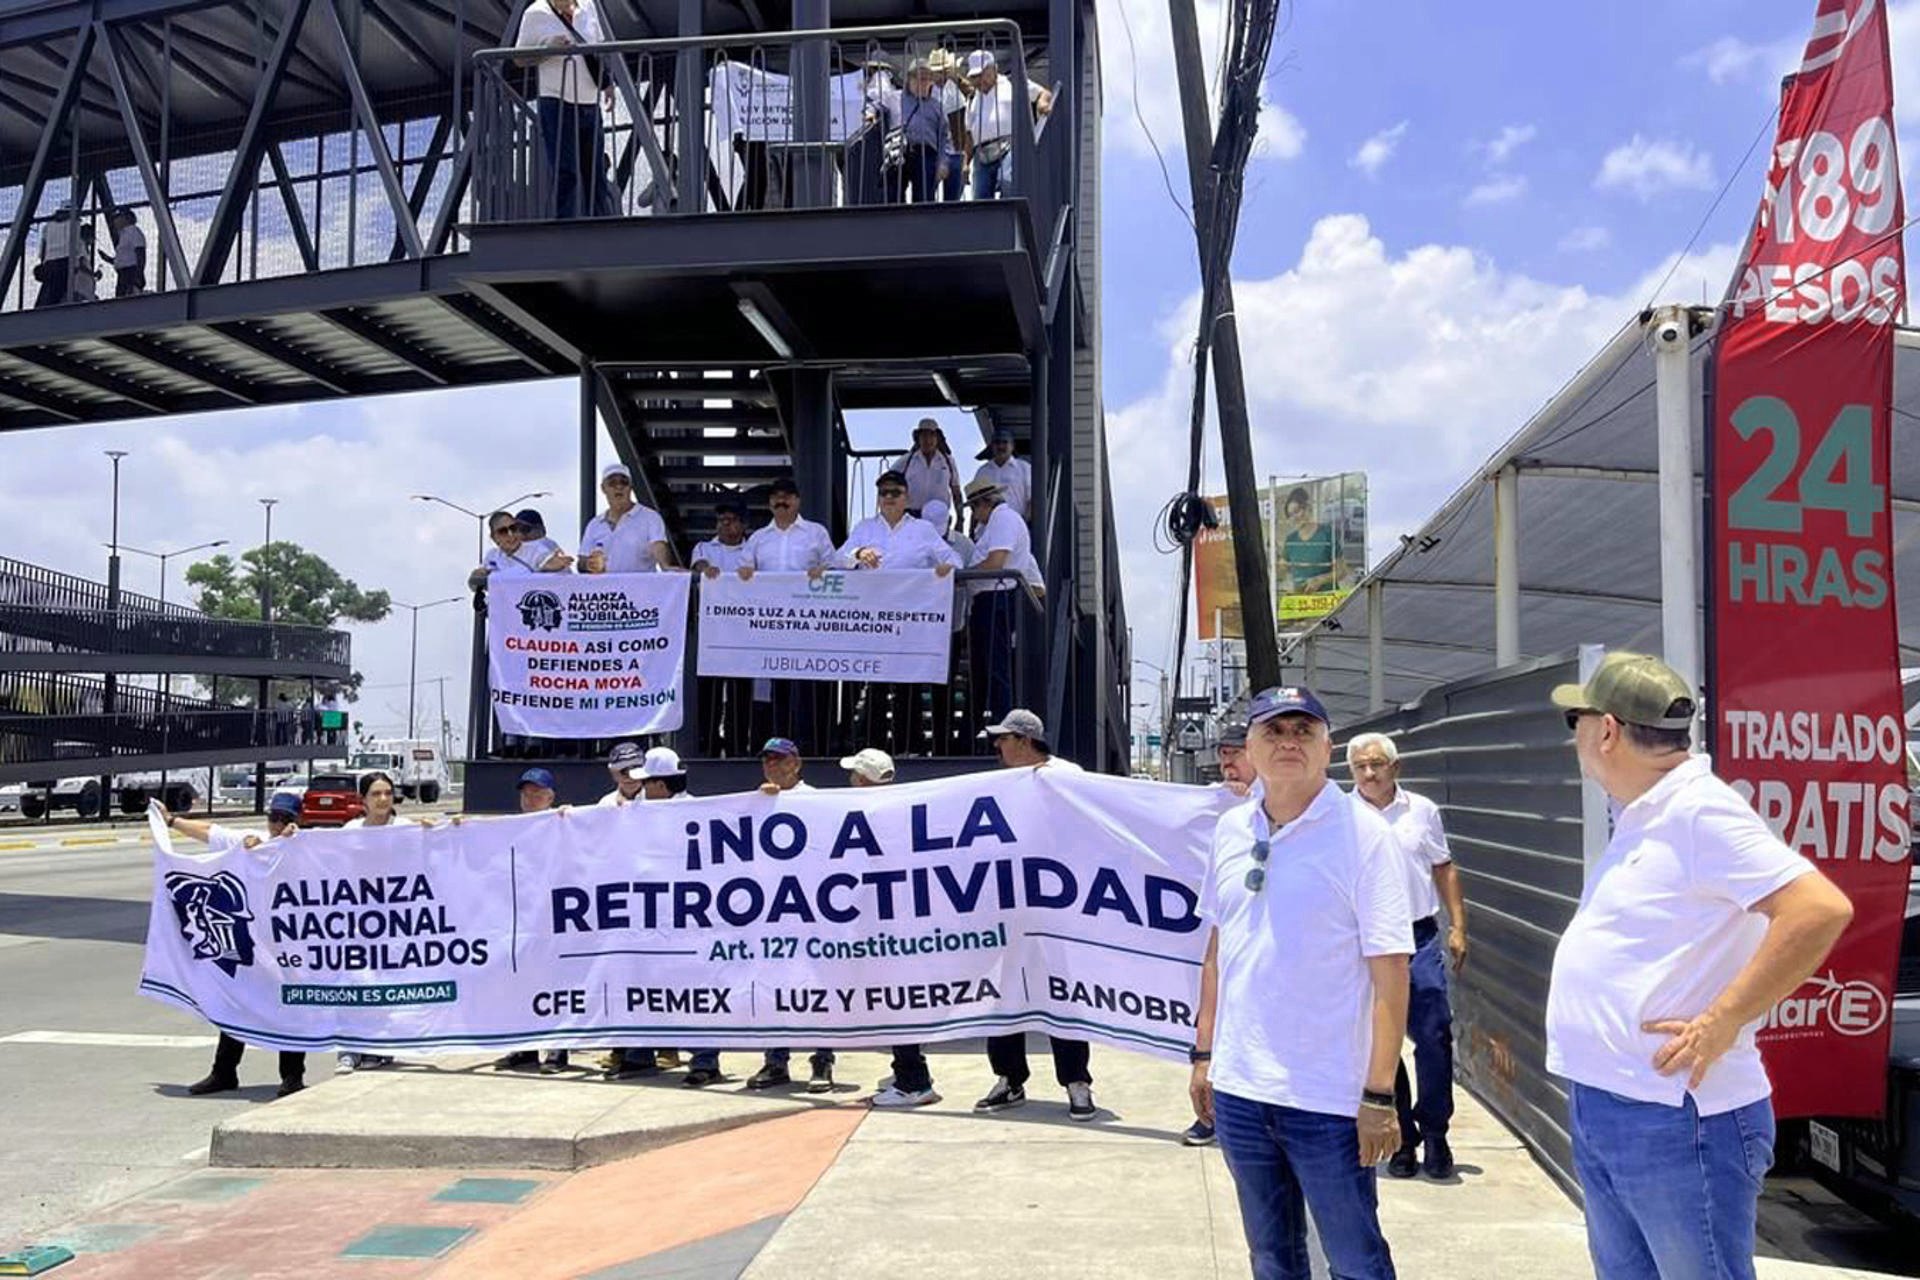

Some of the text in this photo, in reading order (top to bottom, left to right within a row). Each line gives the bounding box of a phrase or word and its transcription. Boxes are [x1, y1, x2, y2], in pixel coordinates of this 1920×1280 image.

[1732, 256, 1900, 325] PESOS
[1728, 396, 1885, 538] 24
[808, 574, 845, 593] CFE
[1728, 542, 1888, 609] HRAS
[568, 602, 636, 611] NACIONAL
[569, 592, 627, 601] ALIANZA
[579, 608, 659, 621] JUBILADOS
[714, 606, 755, 617] DIMOS
[758, 607, 784, 618] LUZ
[787, 608, 796, 618] A
[800, 609, 817, 618] LA
[878, 611, 945, 623] RESPETEN
[749, 620, 810, 631] NUESTRA
[506, 637, 669, 654] CLAUDIA ASÍ COMO
[528, 657, 640, 672] DEFIENDES A
[761, 656, 881, 674] JUBILADOS CFE
[530, 676, 642, 690] ROCHA MOYA
[492, 688, 676, 709] DEFIENDE MI PENSIÓN
[1725, 711, 1902, 764] TRASLADO
[685, 796, 1018, 870] ¡NO A LA
[271, 874, 435, 909] ALIANZA
[552, 857, 1202, 935] RETROACTIVIDAD
[271, 906, 456, 942] NACIONAL
[276, 938, 489, 971] de JUBILADOS
[709, 922, 1008, 961] Art. 127 Constitucional
[306, 988, 358, 1003] PENSIÓN
[362, 989, 381, 1002] ES
[385, 985, 451, 1001] GANADA!
[532, 990, 586, 1017] CFE
[626, 987, 732, 1014] PEMEX
[775, 978, 1001, 1013] LUZ Y FUERZA
[1049, 976, 1199, 1028] BANOBR
